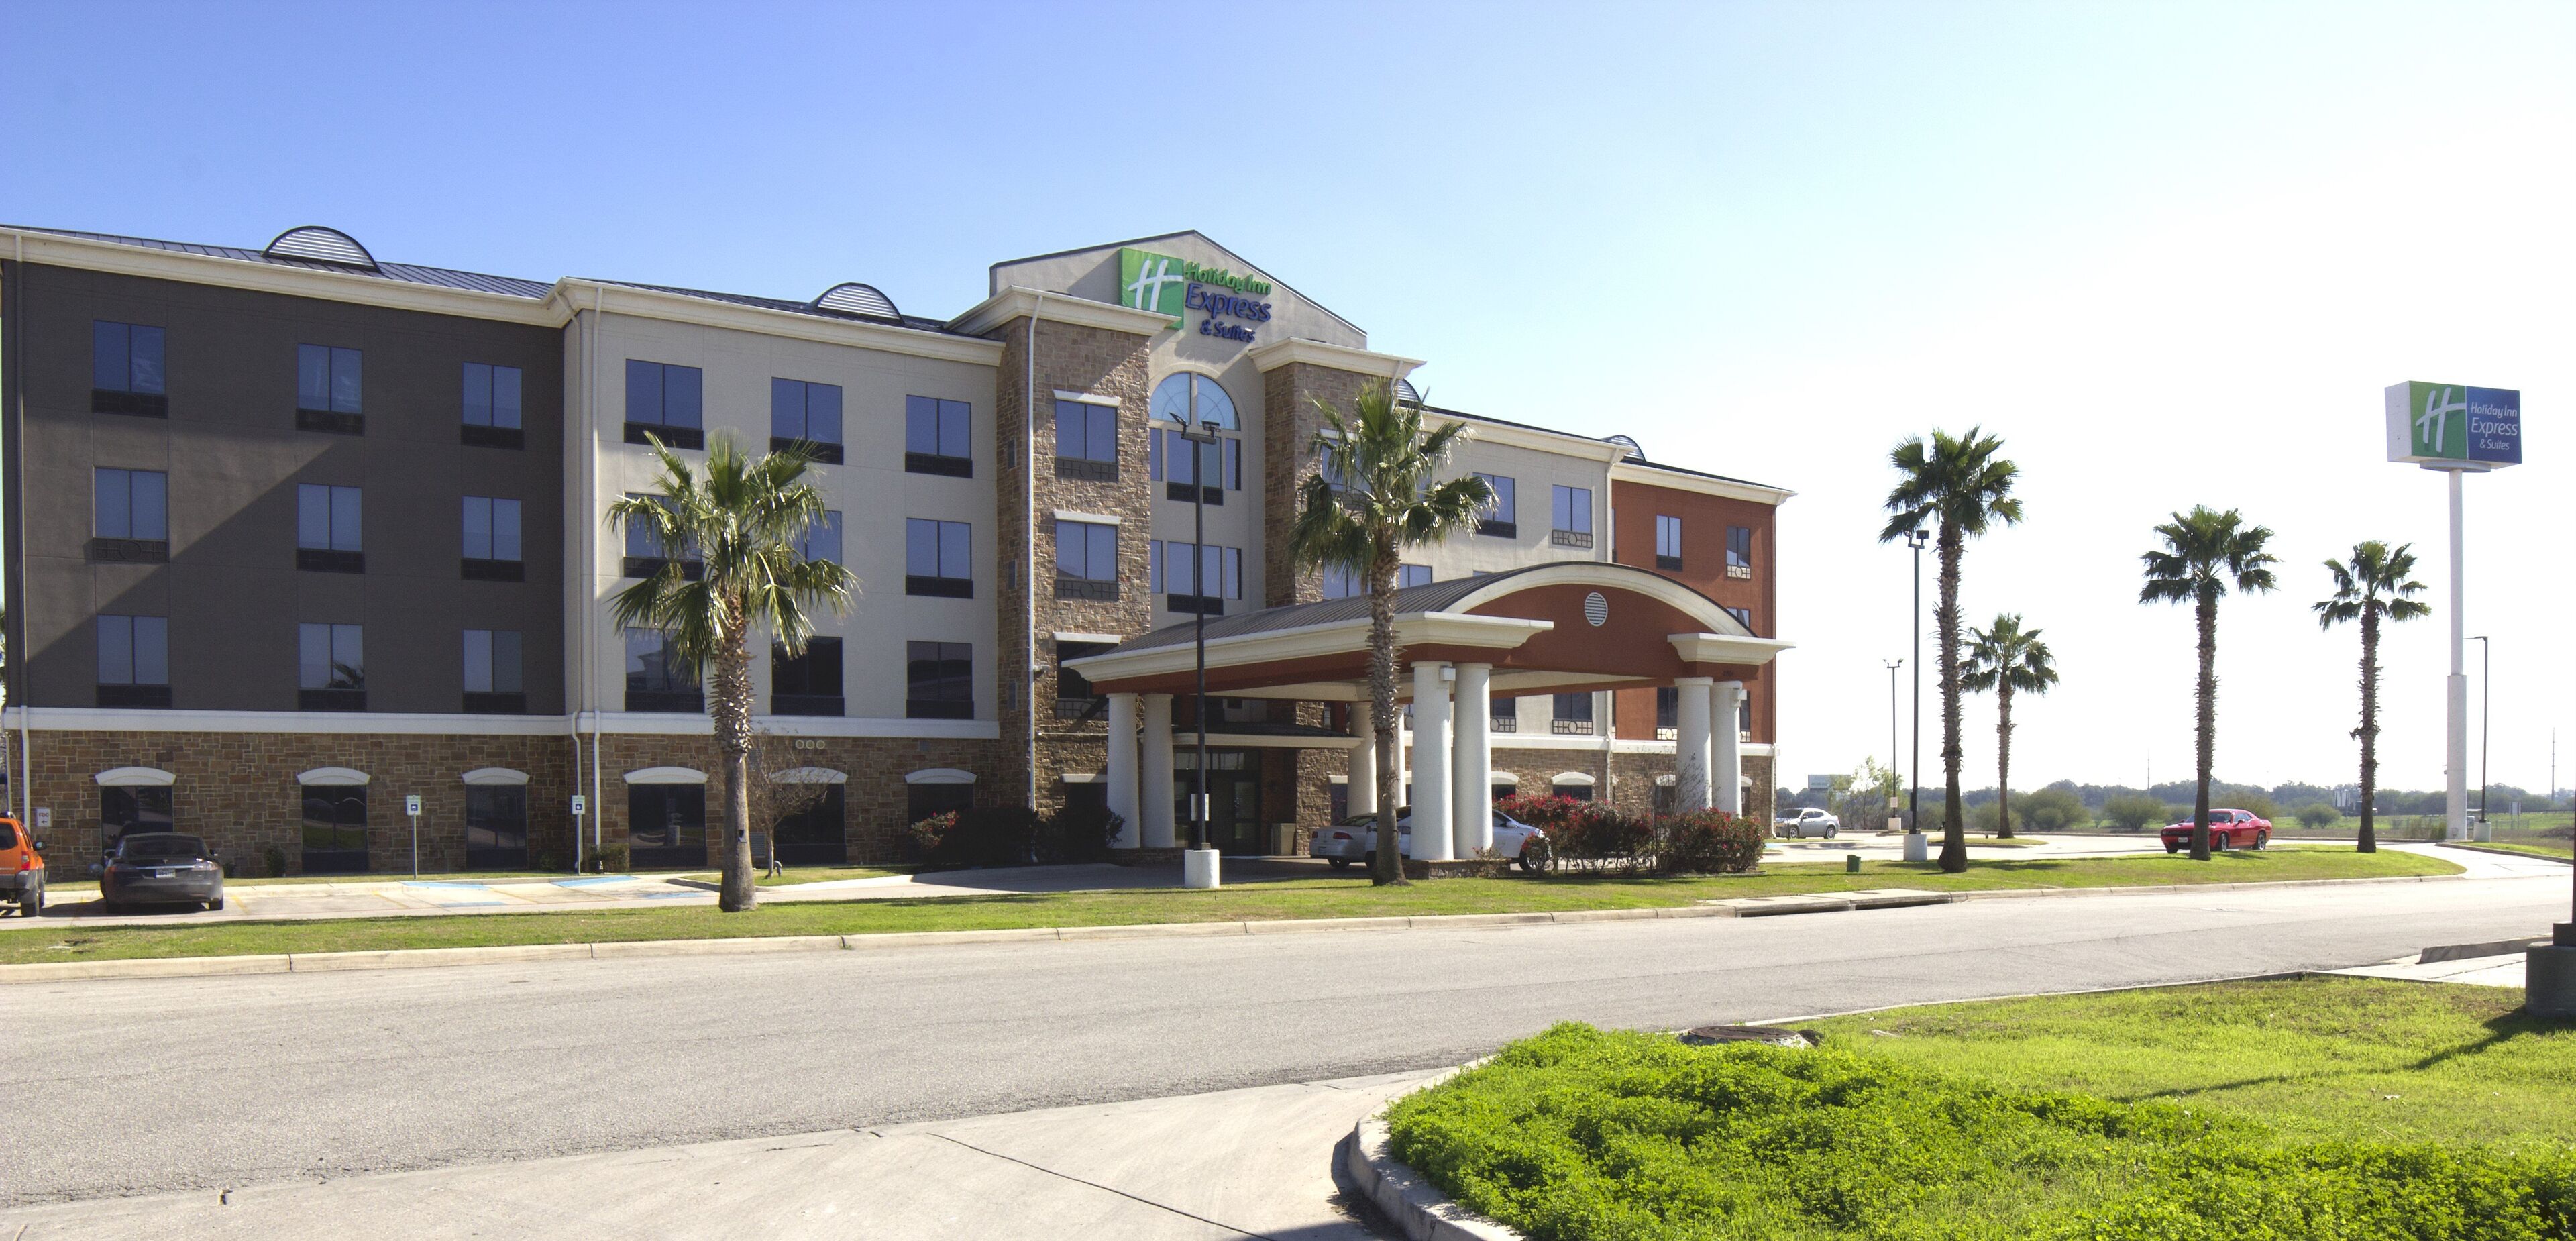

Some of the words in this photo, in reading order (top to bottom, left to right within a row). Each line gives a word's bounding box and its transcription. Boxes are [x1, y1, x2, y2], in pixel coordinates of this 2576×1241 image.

[1185, 261, 1246, 294] Holiday
[1246, 274, 1271, 295] Inn
[1185, 283, 1272, 322] Express
[1200, 319, 1212, 335] &
[1214, 321, 1256, 343] Suites
[2471, 402, 2502, 418] Holiday
[2504, 405, 2517, 417] Inn
[2471, 417, 2518, 437] Express
[2479, 439, 2485, 449] &
[2487, 439, 2510, 450] Suites
